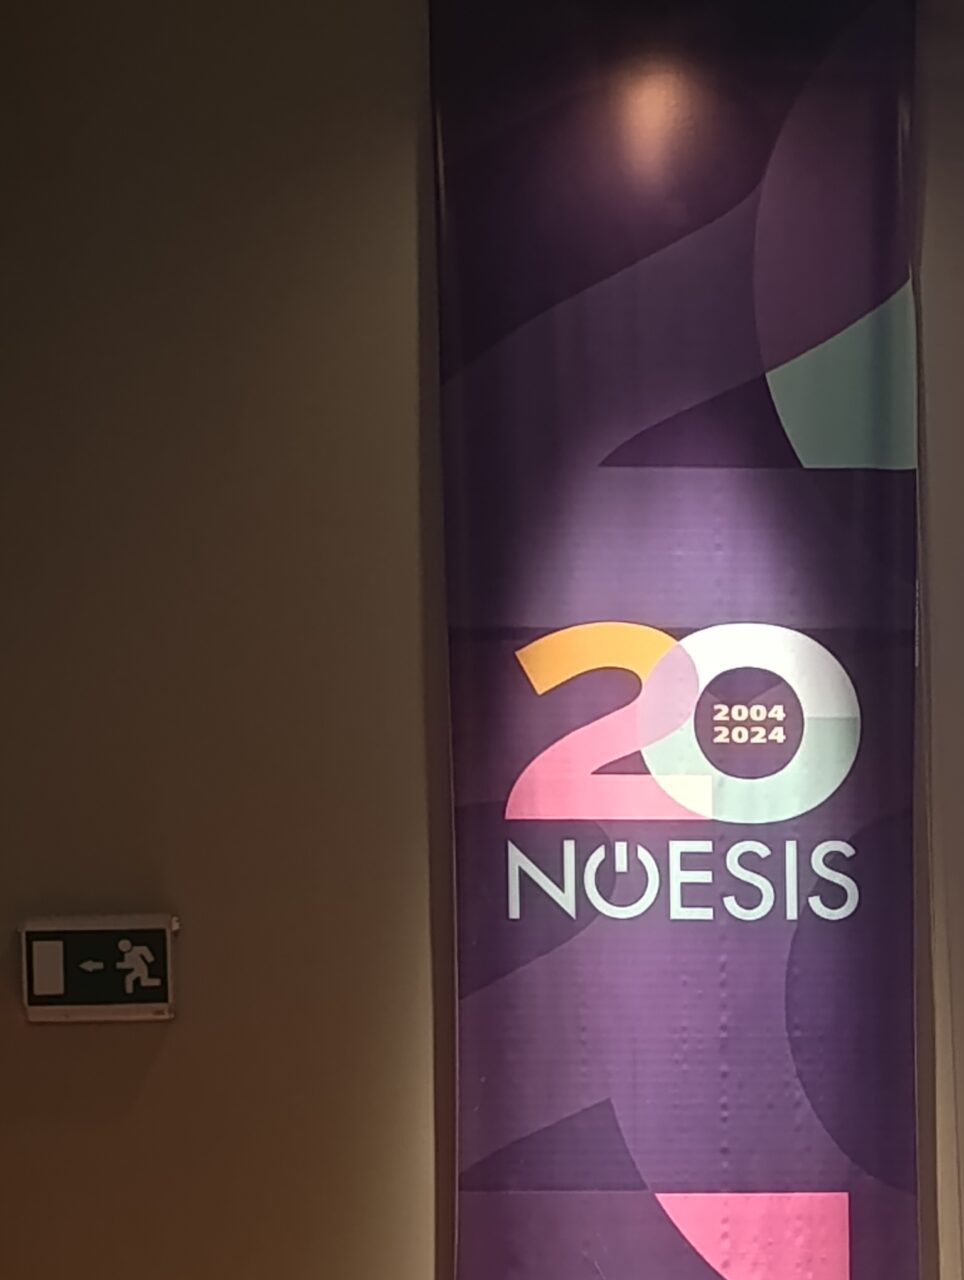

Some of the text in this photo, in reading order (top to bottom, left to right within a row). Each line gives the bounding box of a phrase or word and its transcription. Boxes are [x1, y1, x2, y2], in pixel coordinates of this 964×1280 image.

[505, 621, 861, 824] 20
[712, 704, 786, 721] 2004
[712, 726, 786, 743] 2024
[507, 839, 860, 921] NOESIS
